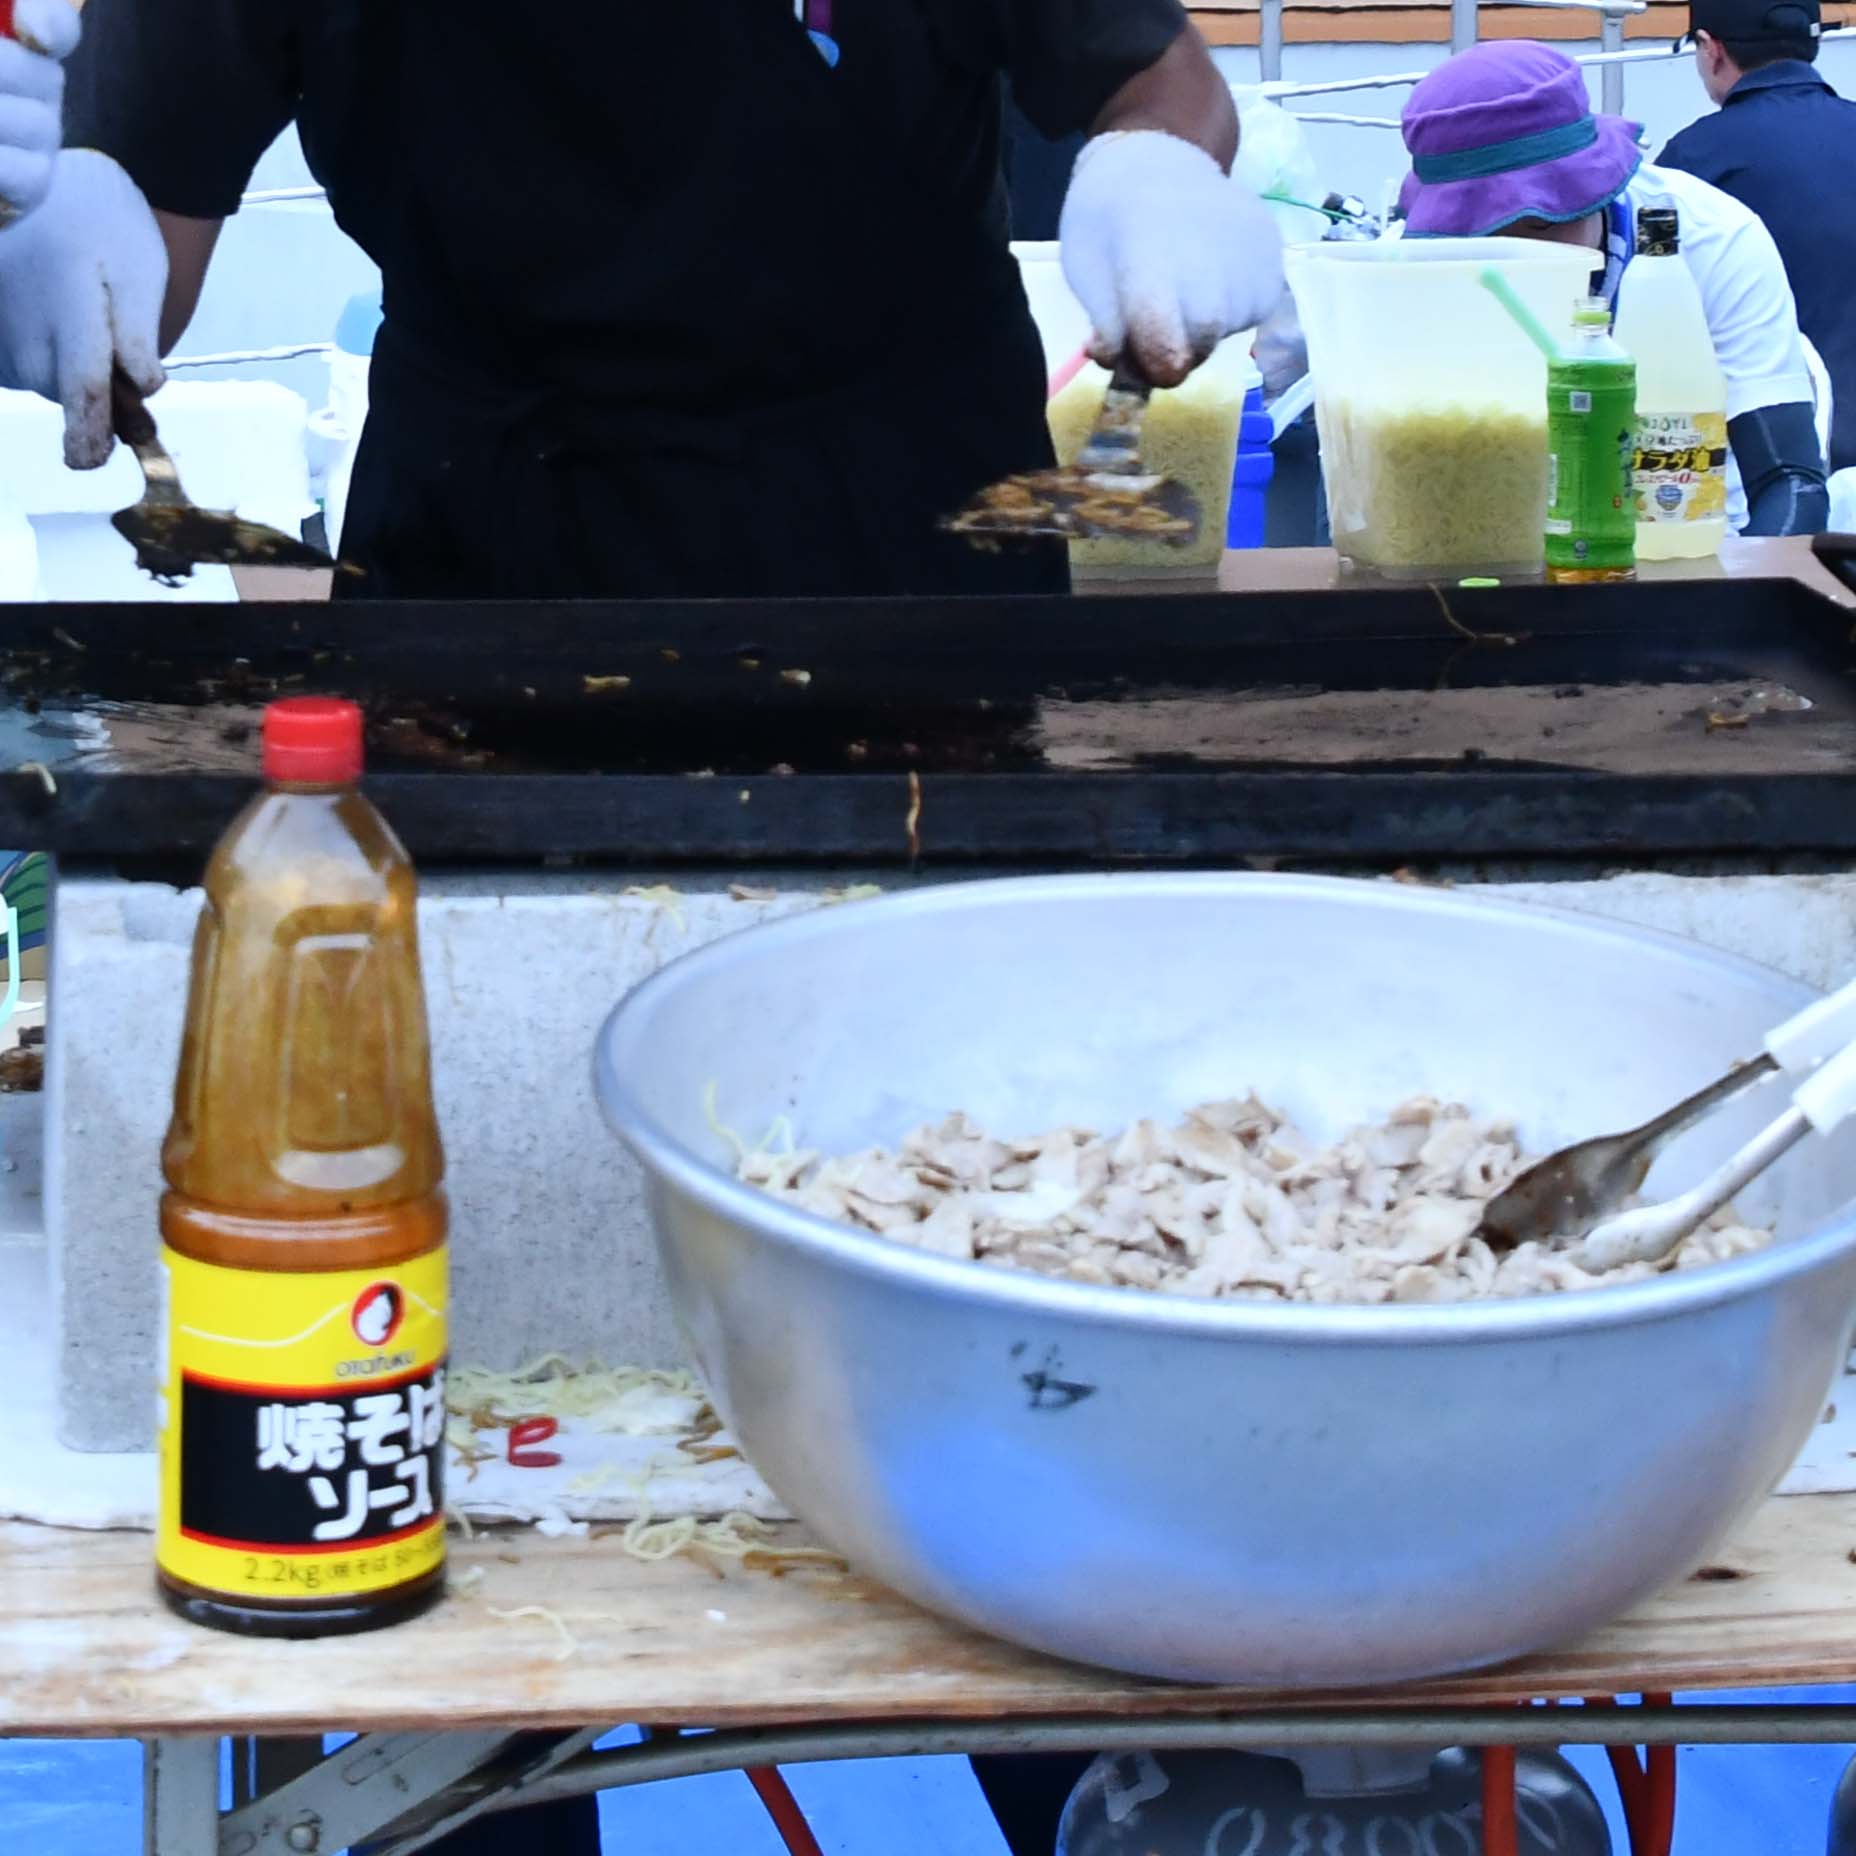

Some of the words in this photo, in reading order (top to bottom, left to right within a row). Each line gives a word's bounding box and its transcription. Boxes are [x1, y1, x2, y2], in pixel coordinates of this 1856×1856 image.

[256, 1367, 444, 1473] 焼そば
[308, 1454, 433, 1541] ソース
[245, 1557, 321, 1588] 2.2kg
